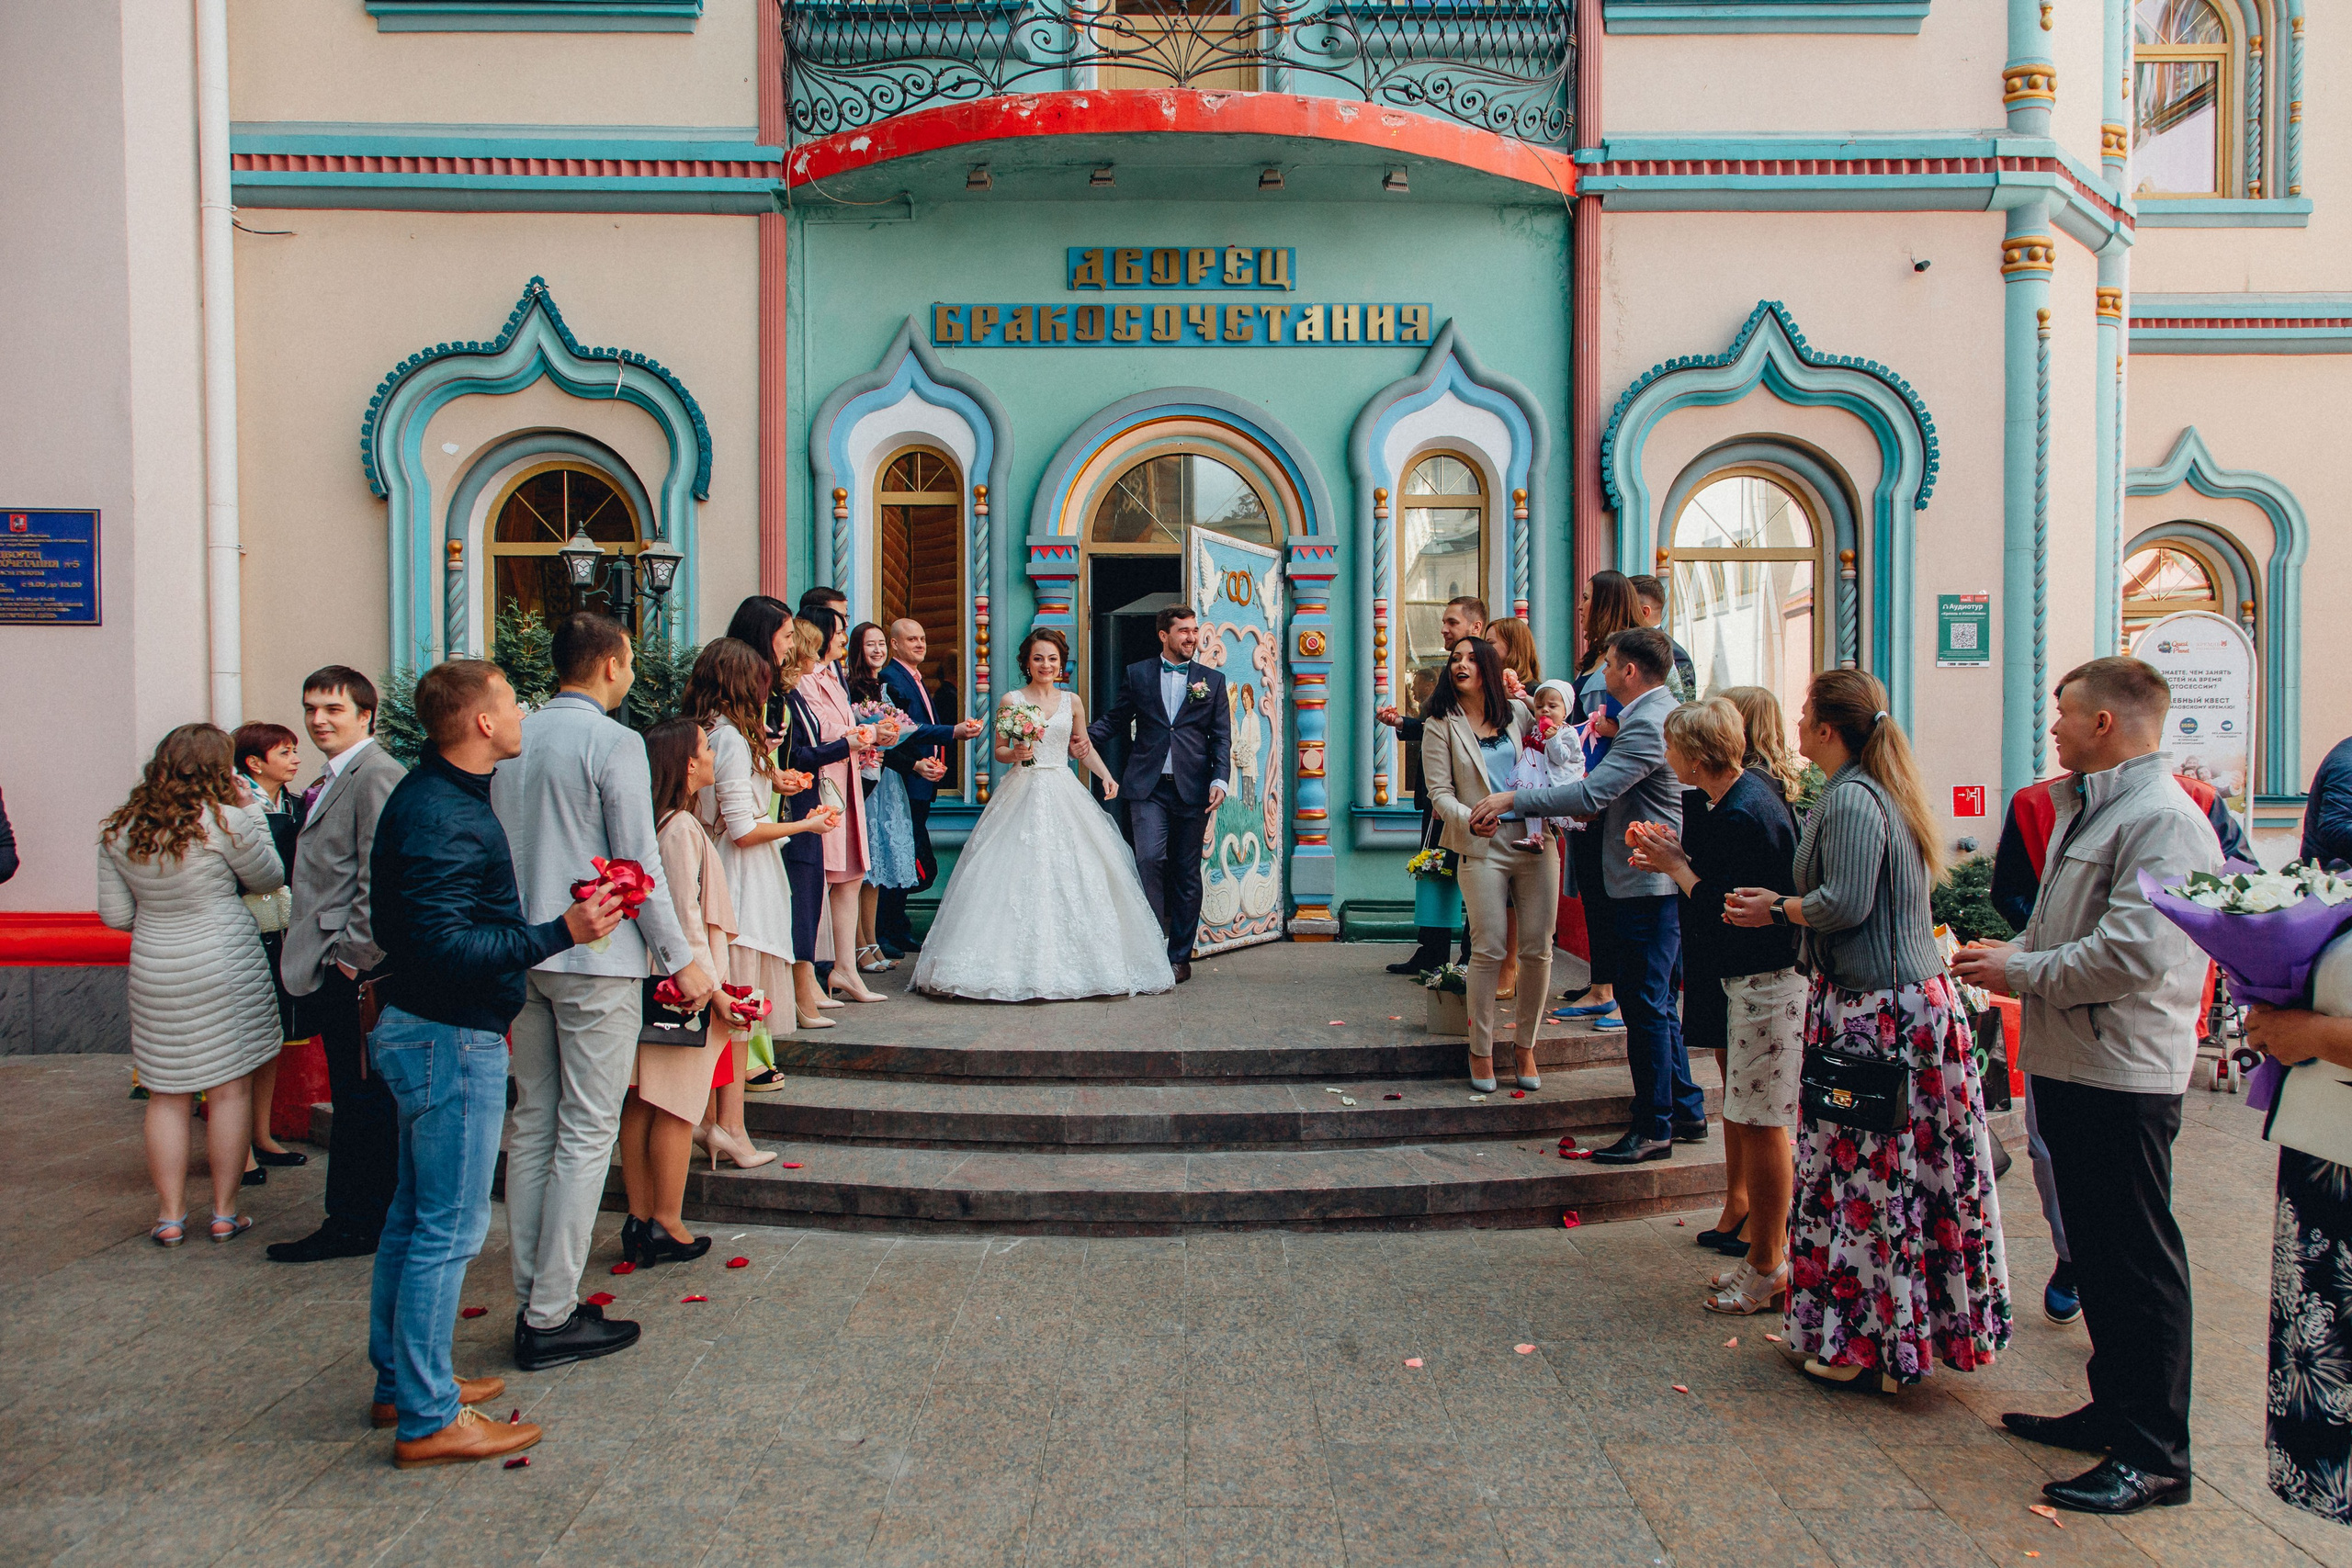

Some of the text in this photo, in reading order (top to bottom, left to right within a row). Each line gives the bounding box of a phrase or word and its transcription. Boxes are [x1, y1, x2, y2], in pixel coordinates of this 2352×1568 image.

[1073, 247, 1291, 291] ДВОРЕЦ
[935, 303, 1430, 342] БРАКОСОЧЕТАНИЯ
[0, 559, 59, 568] ОЧЕТАНИЯ
[1949, 603, 1984, 611] Аудиотур
